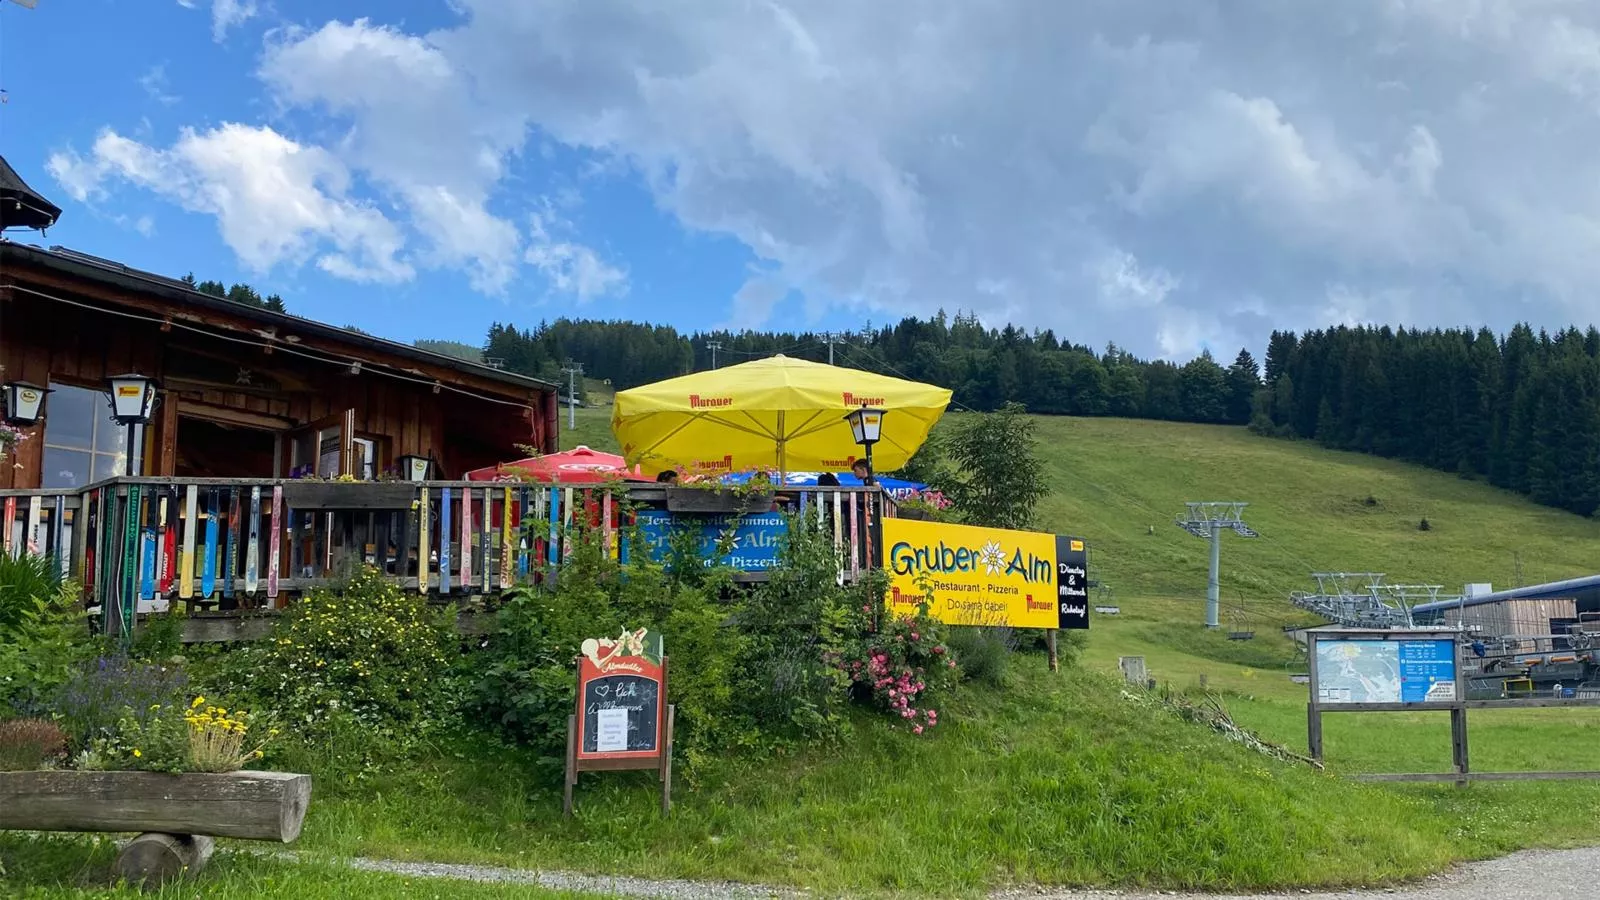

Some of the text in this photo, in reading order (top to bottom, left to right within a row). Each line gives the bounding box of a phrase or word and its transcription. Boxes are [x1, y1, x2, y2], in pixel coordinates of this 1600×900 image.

[689, 394, 733, 409] Murauer
[842, 392, 885, 407] Murauer
[501, 543, 509, 585] ATOMIC
[890, 540, 1052, 585] Gruber Alm
[1059, 563, 1085, 578] Dienstag
[1068, 574, 1076, 585] &
[934, 580, 980, 592] Restaurant
[987, 583, 1019, 595] Pizzeria
[892, 586, 925, 607] Murauer
[947, 598, 961, 610] Do
[1026, 594, 1053, 613] Murauer
[1061, 602, 1086, 618] Ruhetag!
